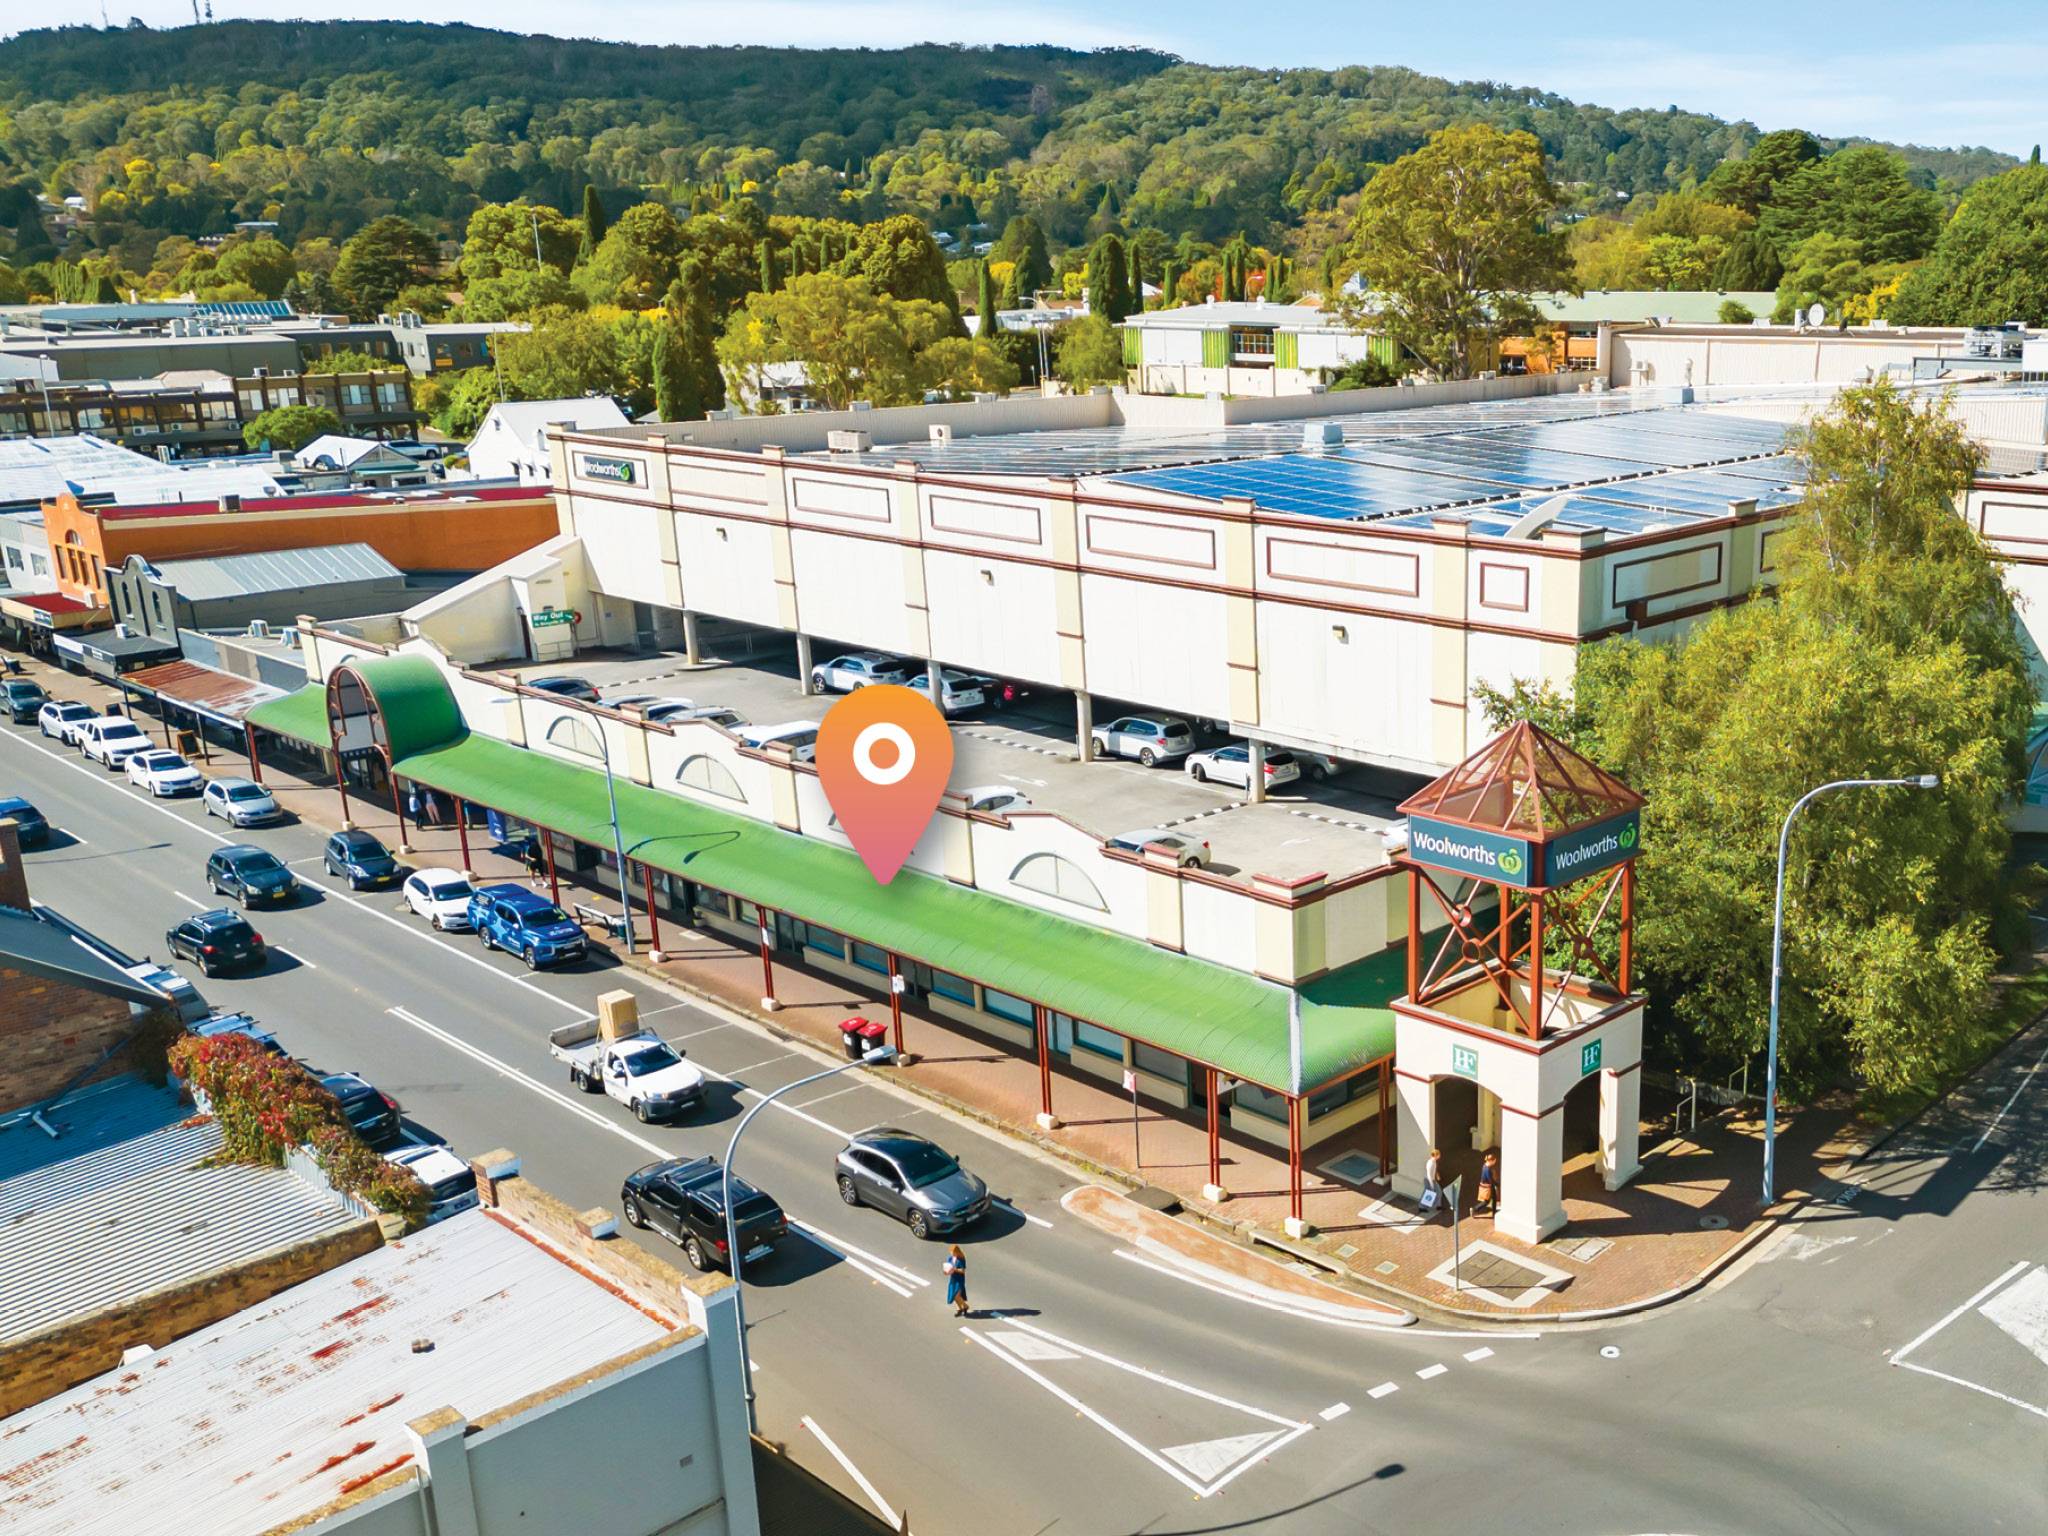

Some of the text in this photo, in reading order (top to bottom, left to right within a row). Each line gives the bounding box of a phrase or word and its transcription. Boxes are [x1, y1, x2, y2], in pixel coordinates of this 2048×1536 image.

[584, 461, 621, 477] Woolworths
[550, 611, 564, 619] Out
[1413, 831, 1496, 866] Woolworths
[1555, 834, 1618, 871] Woolworths
